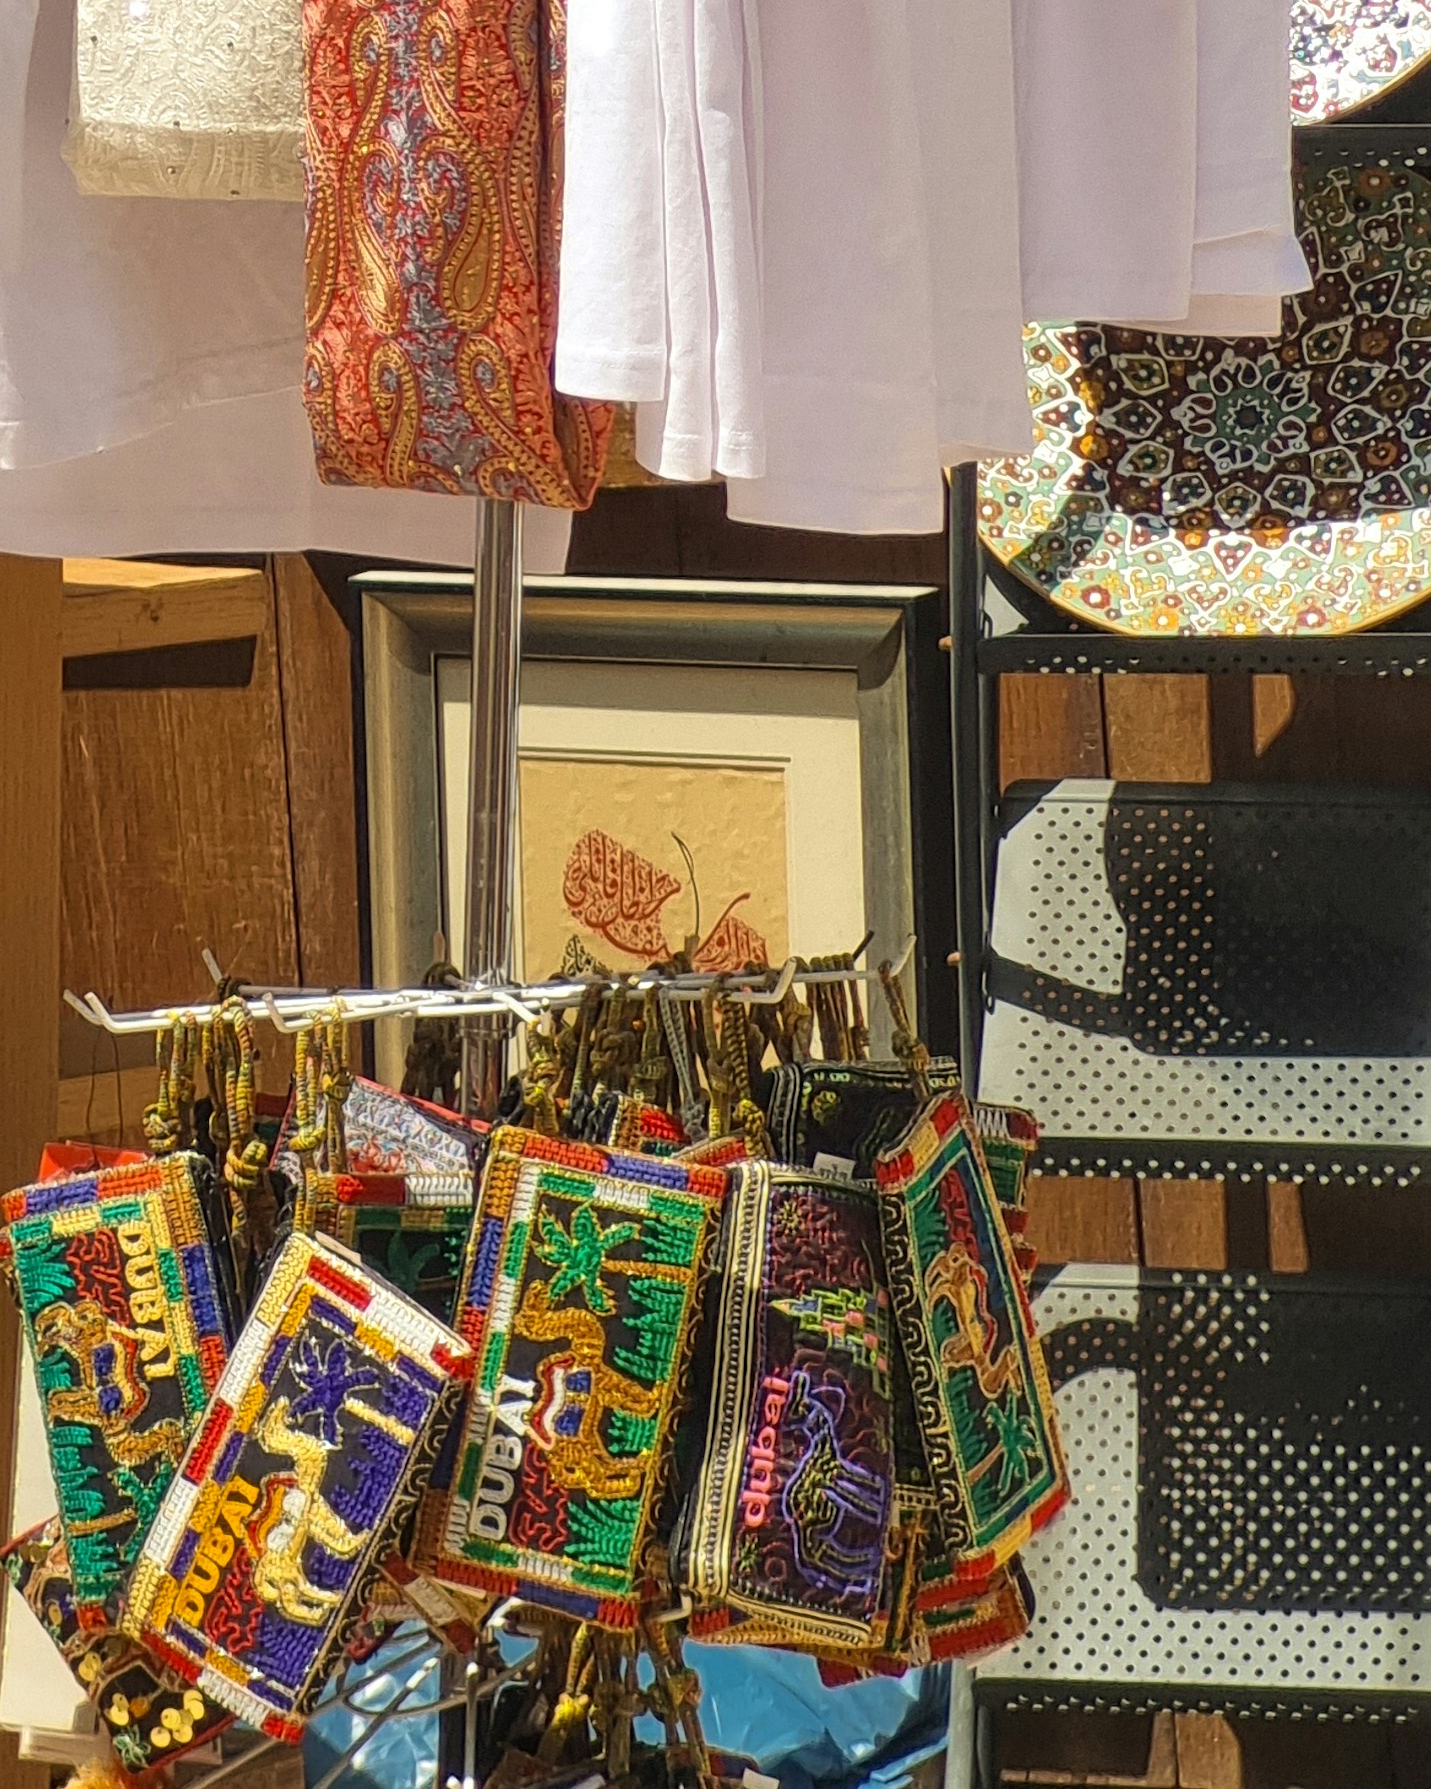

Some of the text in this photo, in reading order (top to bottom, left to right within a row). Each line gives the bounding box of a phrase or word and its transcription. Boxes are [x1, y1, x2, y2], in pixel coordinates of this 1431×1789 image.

[117, 1220, 176, 1381] DUBAI
[469, 1375, 536, 1541] DUBAI
[741, 1367, 789, 1529] dubai
[174, 1475, 260, 1627] DUBAI
